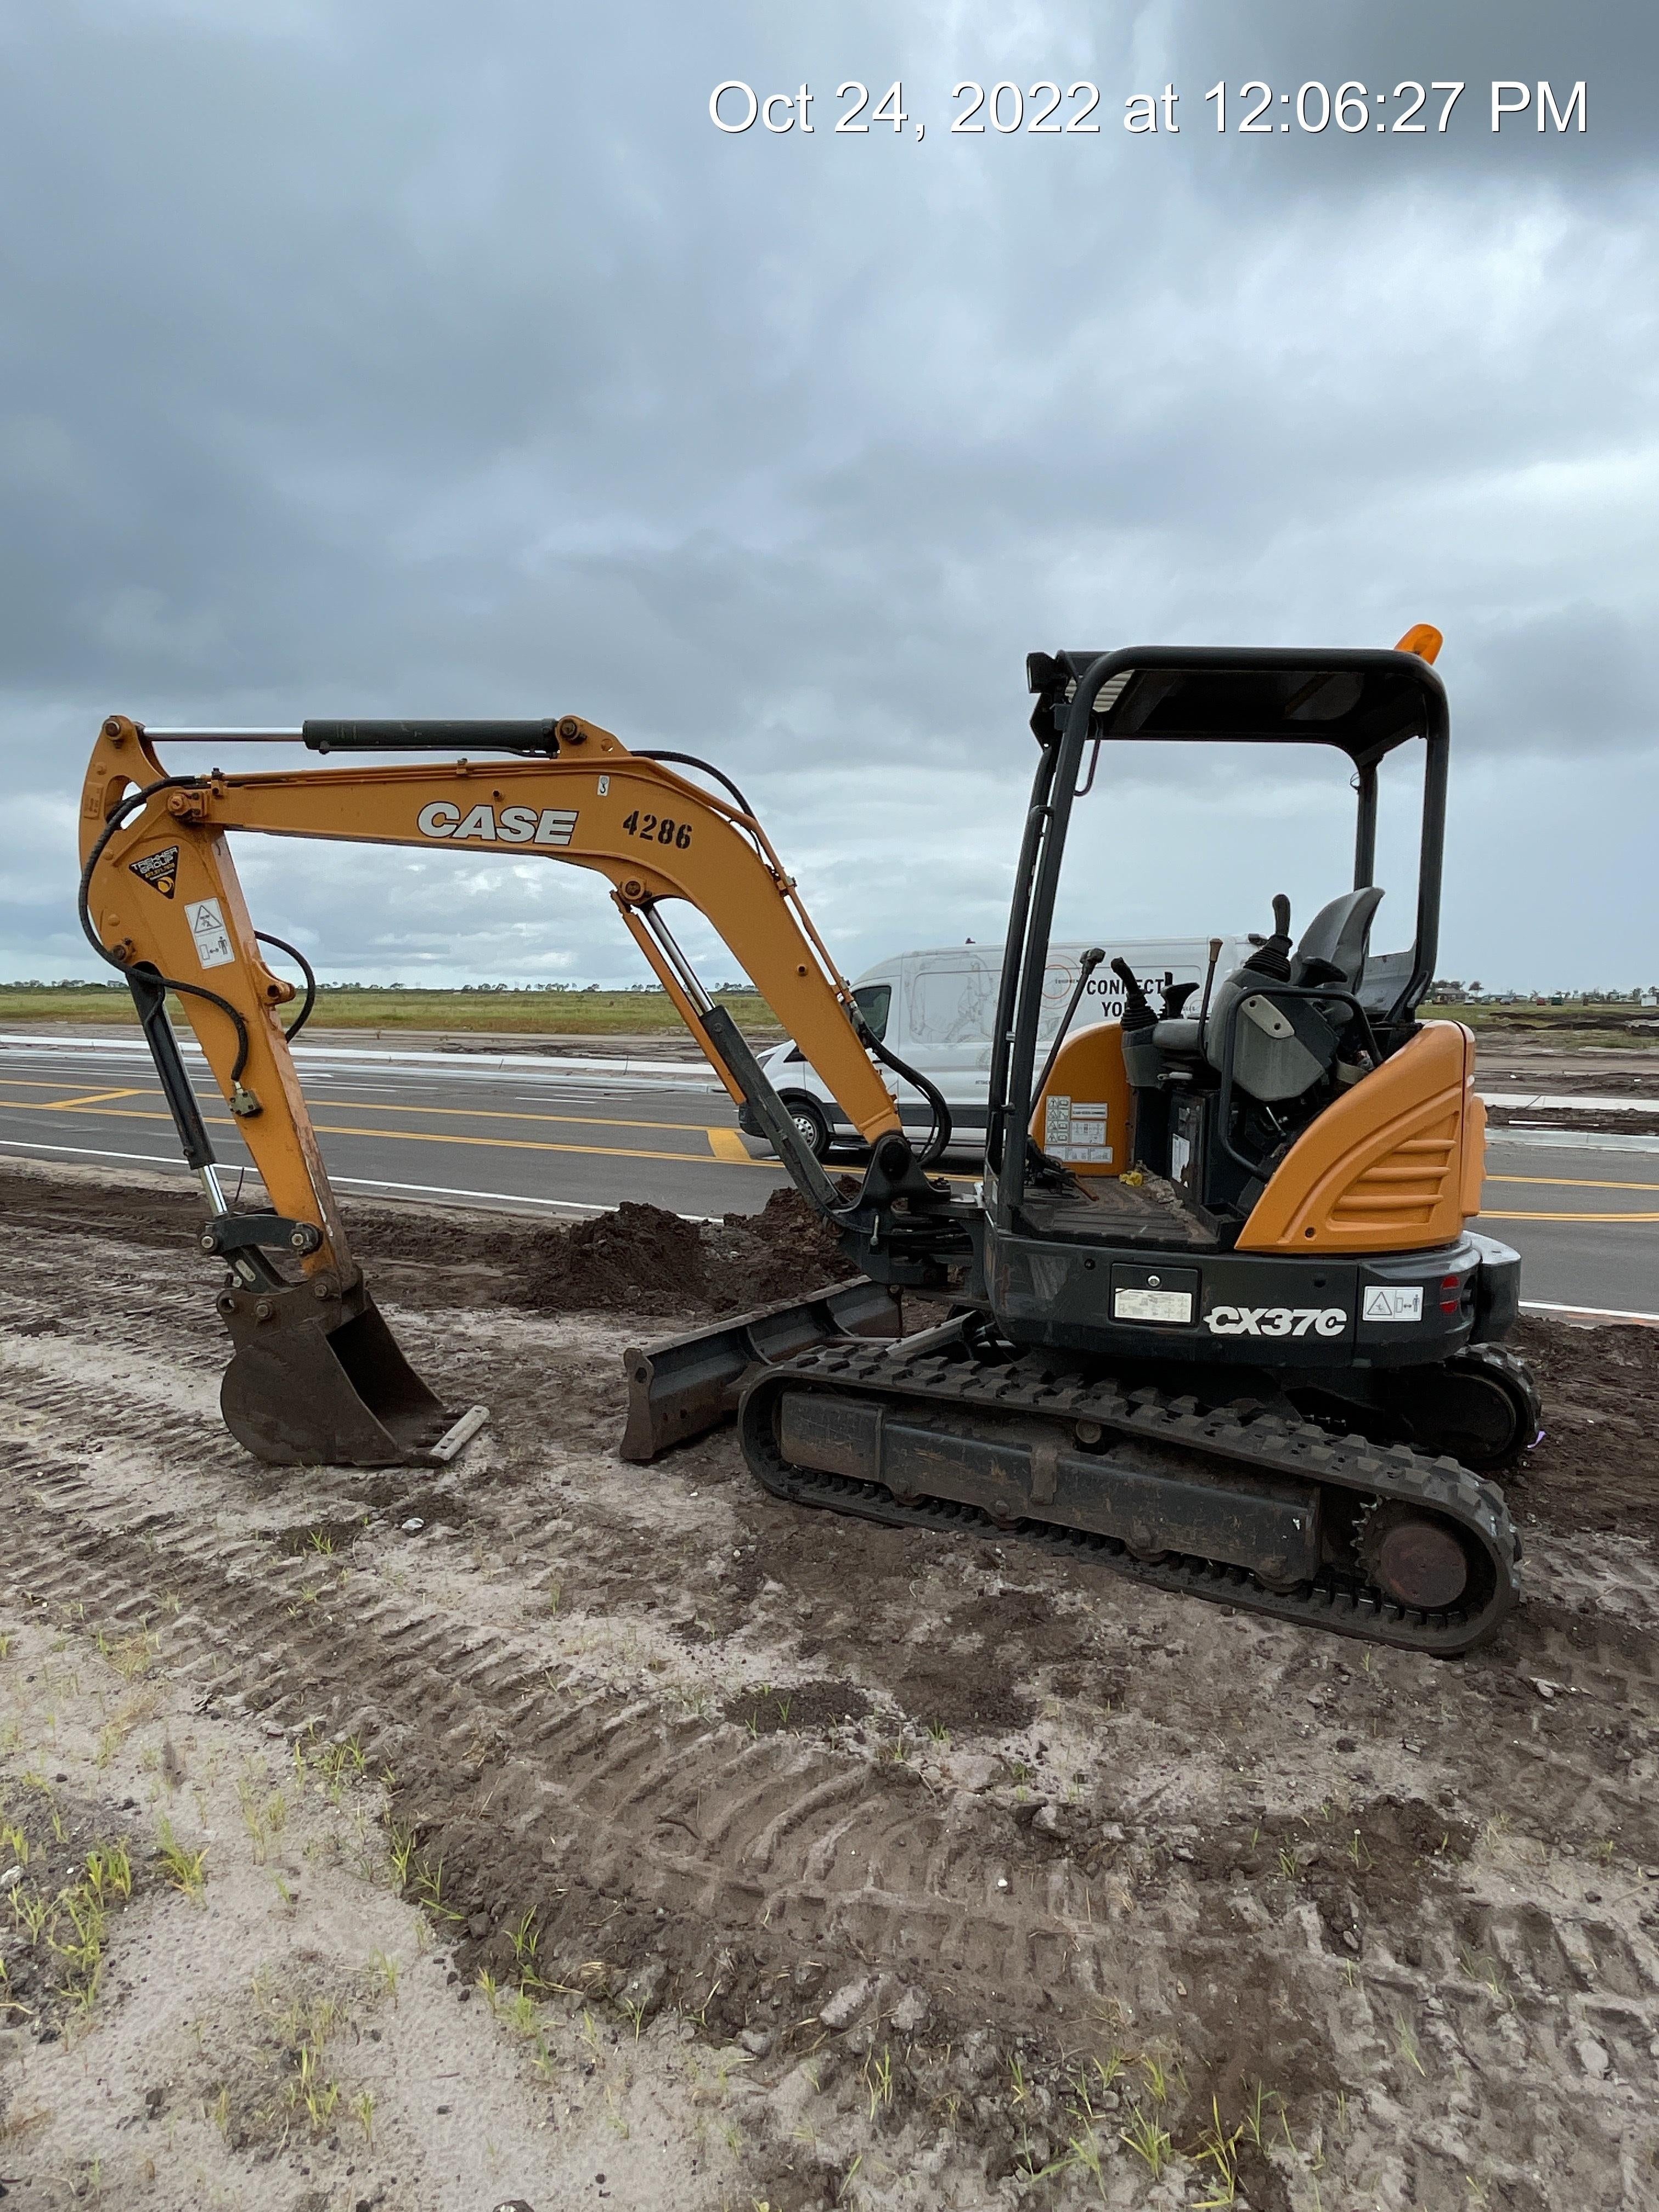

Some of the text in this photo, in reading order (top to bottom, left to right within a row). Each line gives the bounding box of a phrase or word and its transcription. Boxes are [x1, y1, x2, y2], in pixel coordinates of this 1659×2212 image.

[417, 801, 579, 846] CASE
[622, 810, 693, 849] 4286
[1203, 1306, 1347, 1336] CX37C
